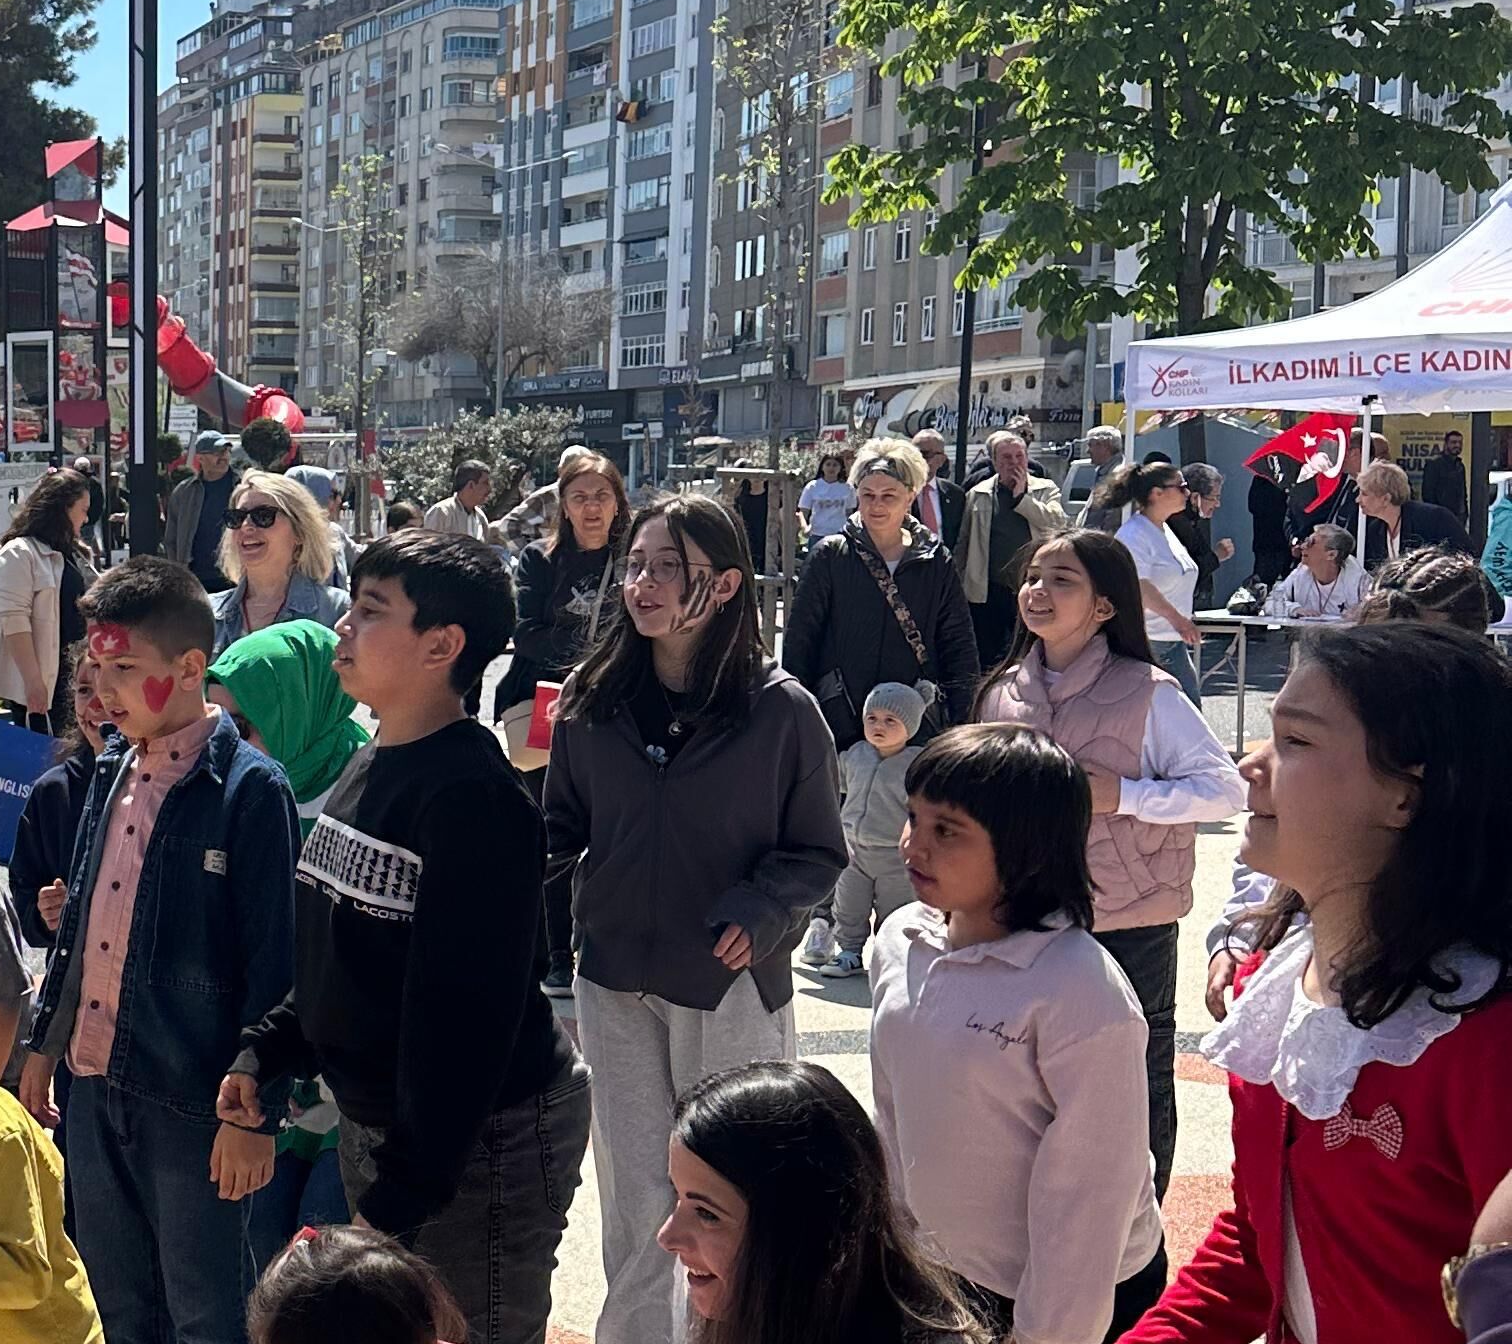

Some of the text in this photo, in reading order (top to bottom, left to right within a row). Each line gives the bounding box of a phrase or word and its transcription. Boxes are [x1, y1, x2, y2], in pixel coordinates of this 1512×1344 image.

[1419, 298, 1512, 316] CH
[1168, 369, 1189, 379] CHP
[1228, 348, 1511, 385] İLKADIM İLÇE KADIN
